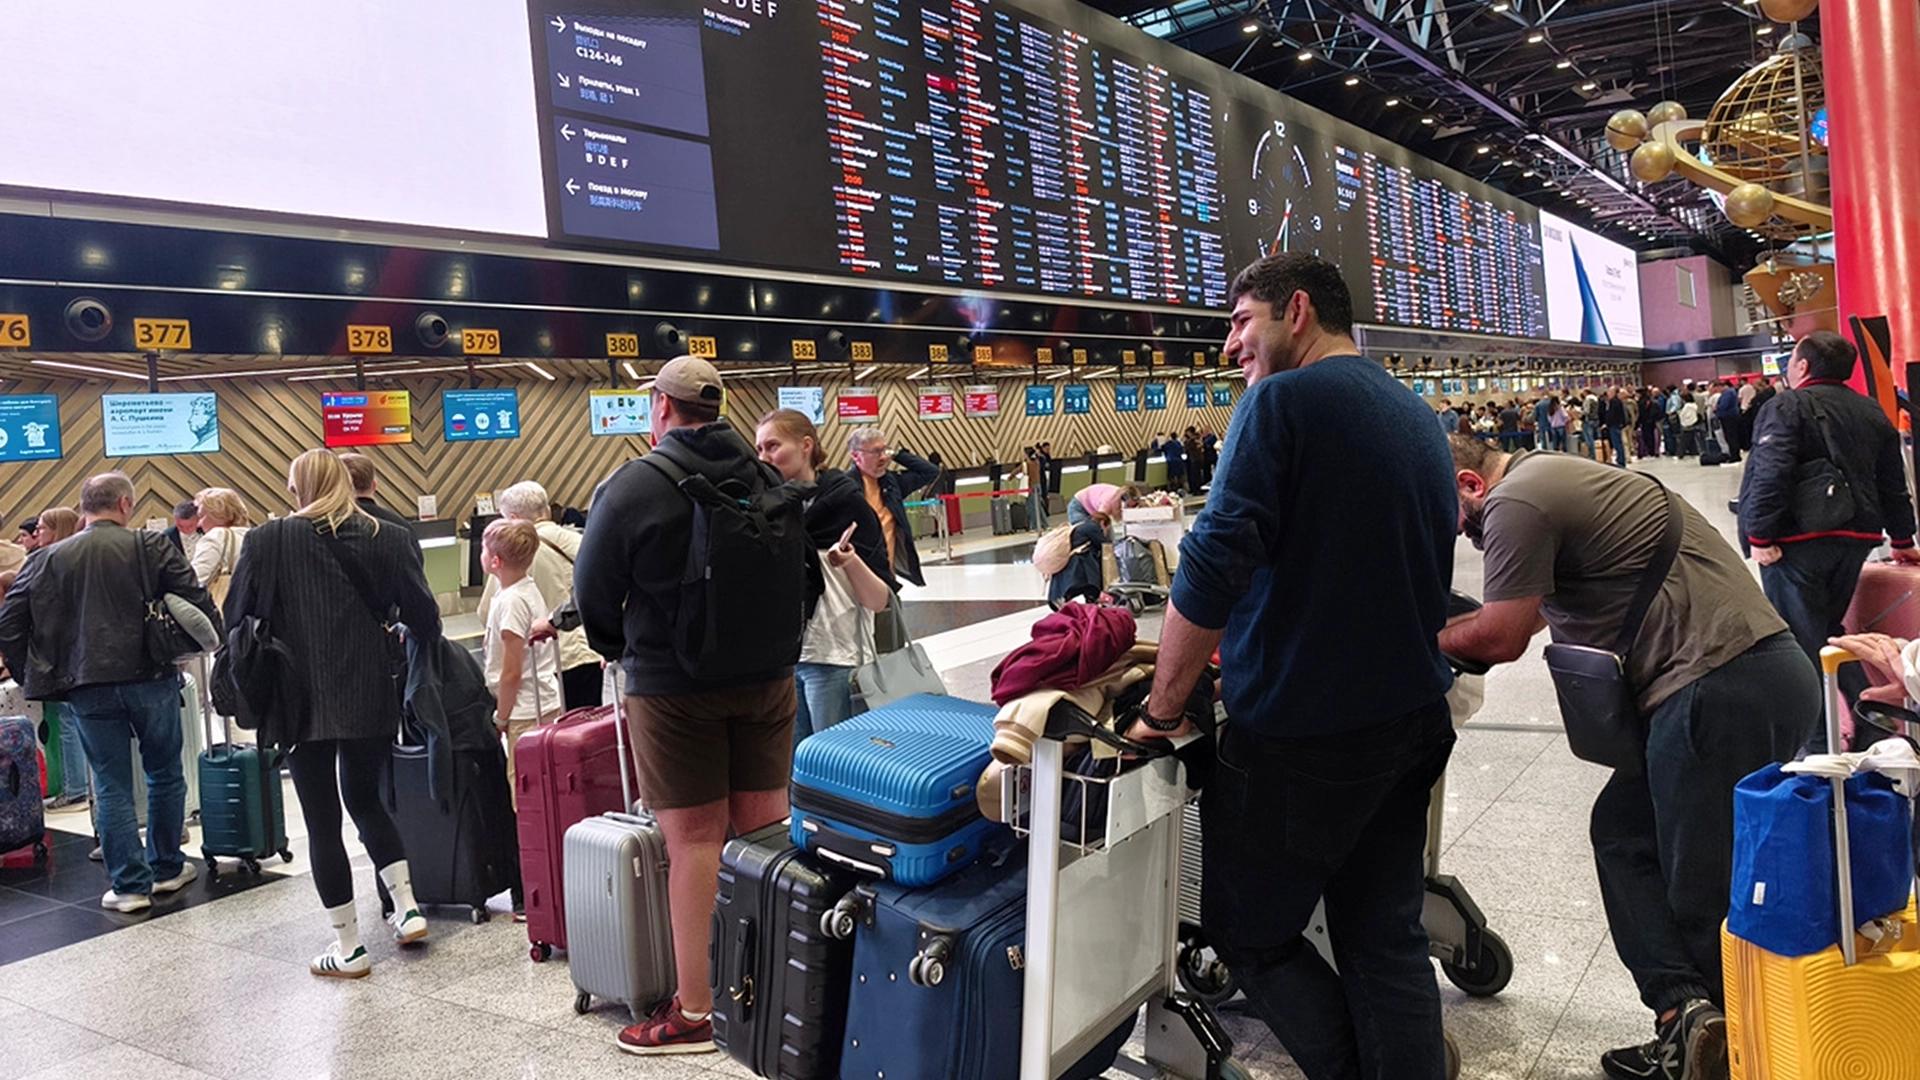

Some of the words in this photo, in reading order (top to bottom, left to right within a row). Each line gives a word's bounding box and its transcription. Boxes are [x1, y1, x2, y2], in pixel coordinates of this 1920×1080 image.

[767, 1, 778, 18] F
[575, 46, 623, 67] C124-146
[585, 153, 593, 164] B
[598, 155, 607, 166] D
[610, 157, 618, 168] E
[621, 159, 629, 169] F
[843, 173, 863, 186] 20:00
[1248, 199, 1258, 215] 9
[1313, 215, 1322, 231] 3
[138, 323, 187, 344] 377
[351, 330, 390, 348] 378
[465, 334, 498, 350] 379
[609, 337, 637, 352] 380
[690, 340, 715, 355] 381
[794, 343, 815, 357] 382
[854, 344, 872, 358] 383
